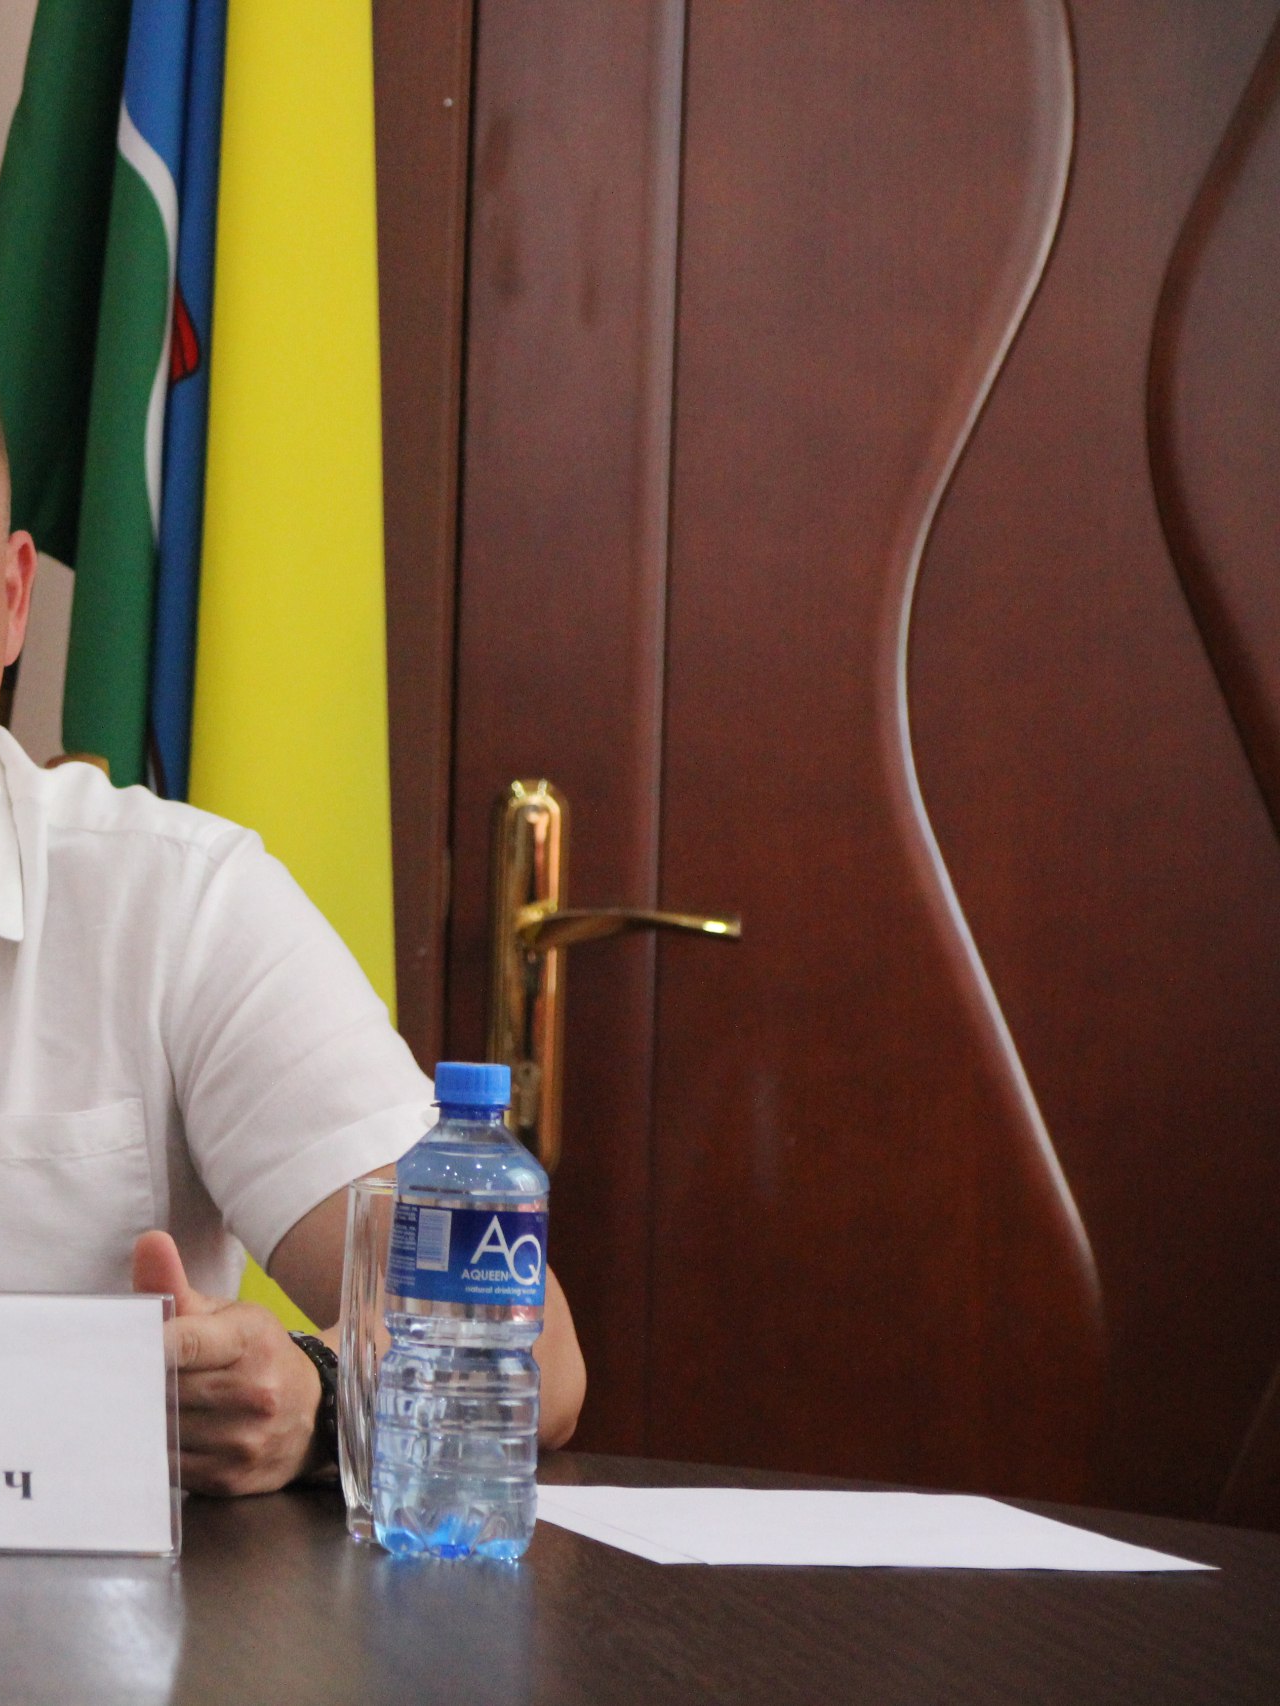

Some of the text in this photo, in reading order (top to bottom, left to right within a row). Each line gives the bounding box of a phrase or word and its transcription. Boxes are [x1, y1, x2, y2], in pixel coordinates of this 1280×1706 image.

[470, 1215, 542, 1286] AQ
[461, 1269, 509, 1283] AQUEEN
[465, 1286, 492, 1294] natural
[495, 1286, 521, 1297] drinking
